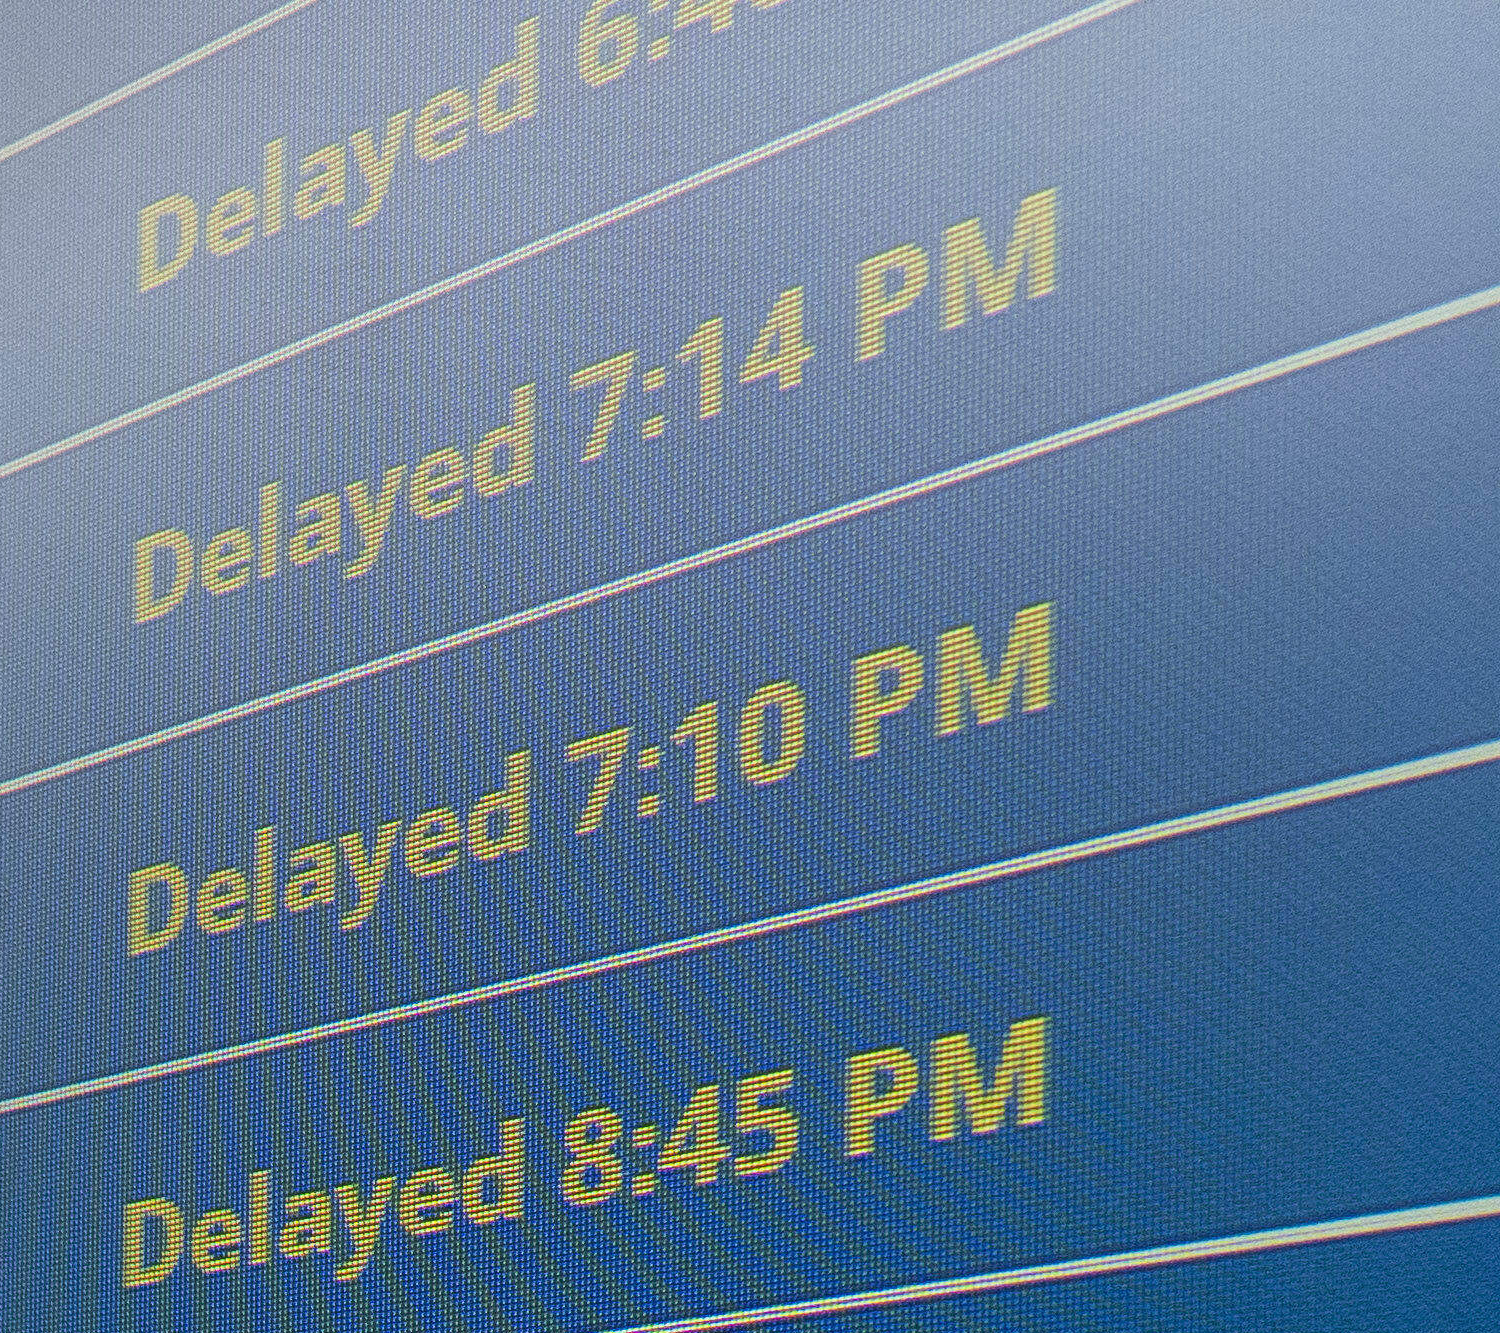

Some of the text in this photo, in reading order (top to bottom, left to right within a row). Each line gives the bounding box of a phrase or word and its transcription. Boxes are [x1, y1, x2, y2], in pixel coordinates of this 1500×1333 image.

[137, 14, 541, 293] Delayed
[131, 381, 538, 626] Delayed
[569, 285, 816, 464] 7:14
[855, 185, 1060, 363] PM
[126, 749, 533, 957] Delayed
[566, 679, 807, 836] 7:10
[850, 601, 1057, 759] PM
[121, 1117, 527, 1289] Delayed
[560, 1068, 801, 1209] 8:45
[844, 1016, 1052, 1158] PM
